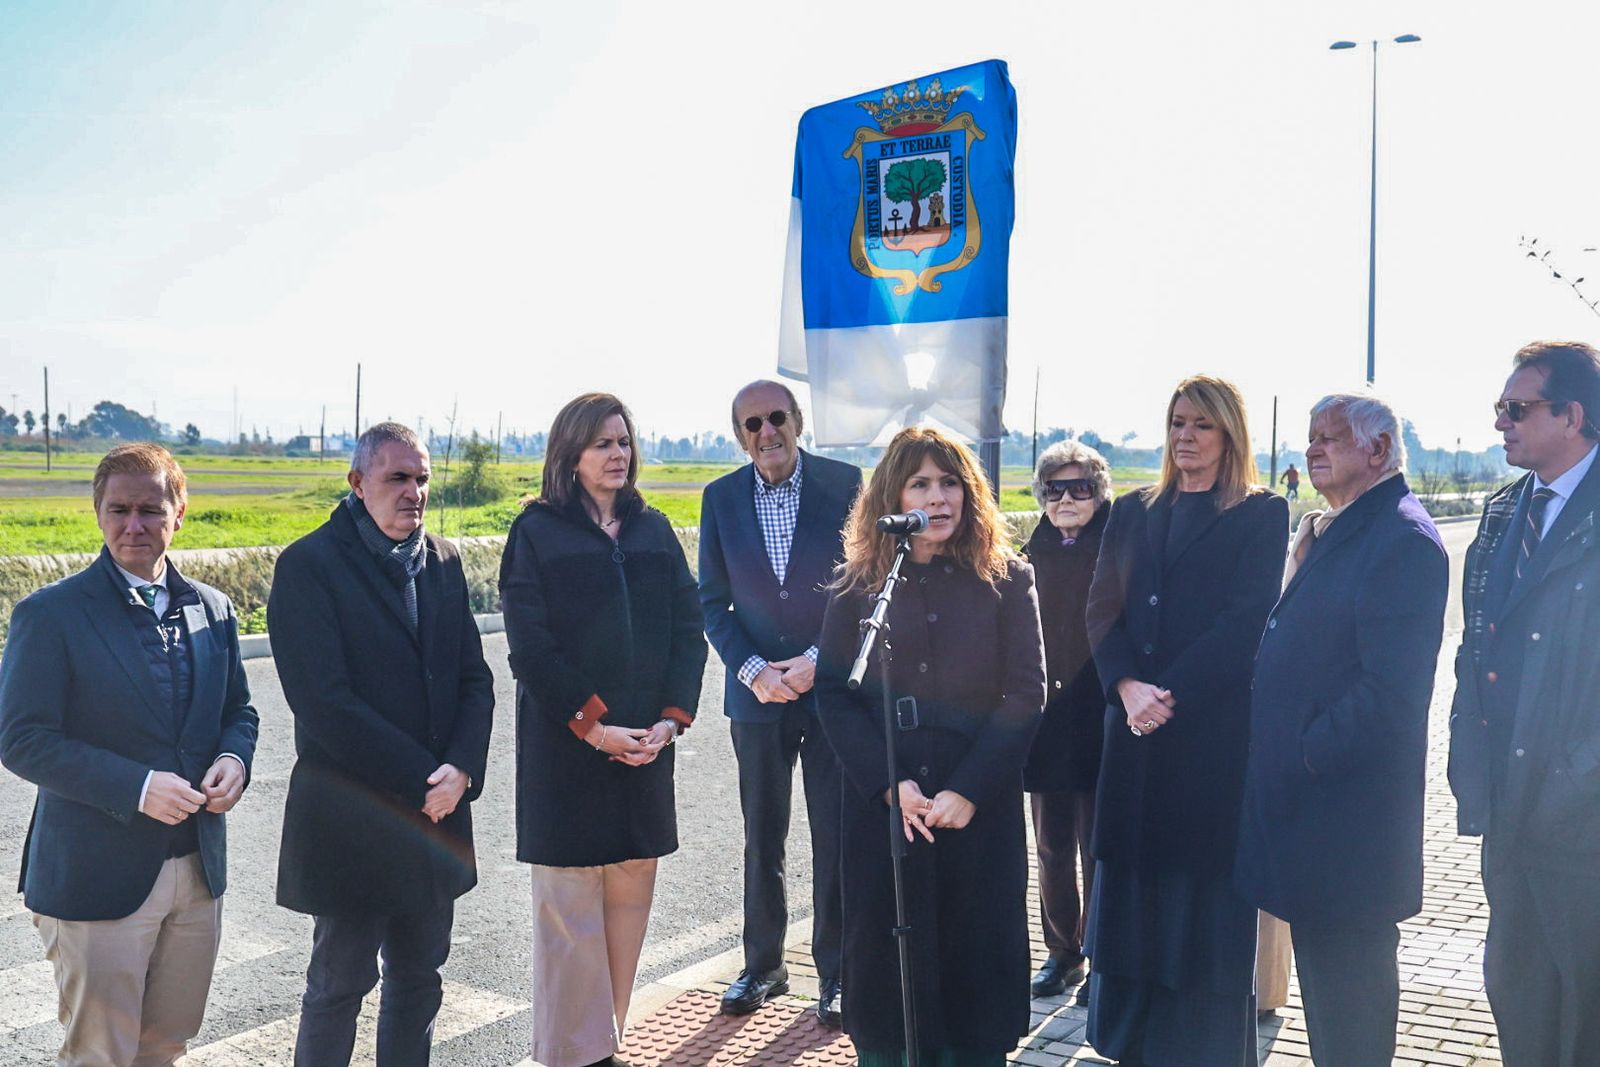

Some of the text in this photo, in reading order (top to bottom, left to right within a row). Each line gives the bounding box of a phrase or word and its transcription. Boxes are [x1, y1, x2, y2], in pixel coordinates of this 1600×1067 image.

[880, 134, 952, 156] ET TERRAE
[866, 158, 880, 250] PORTUS MARIS
